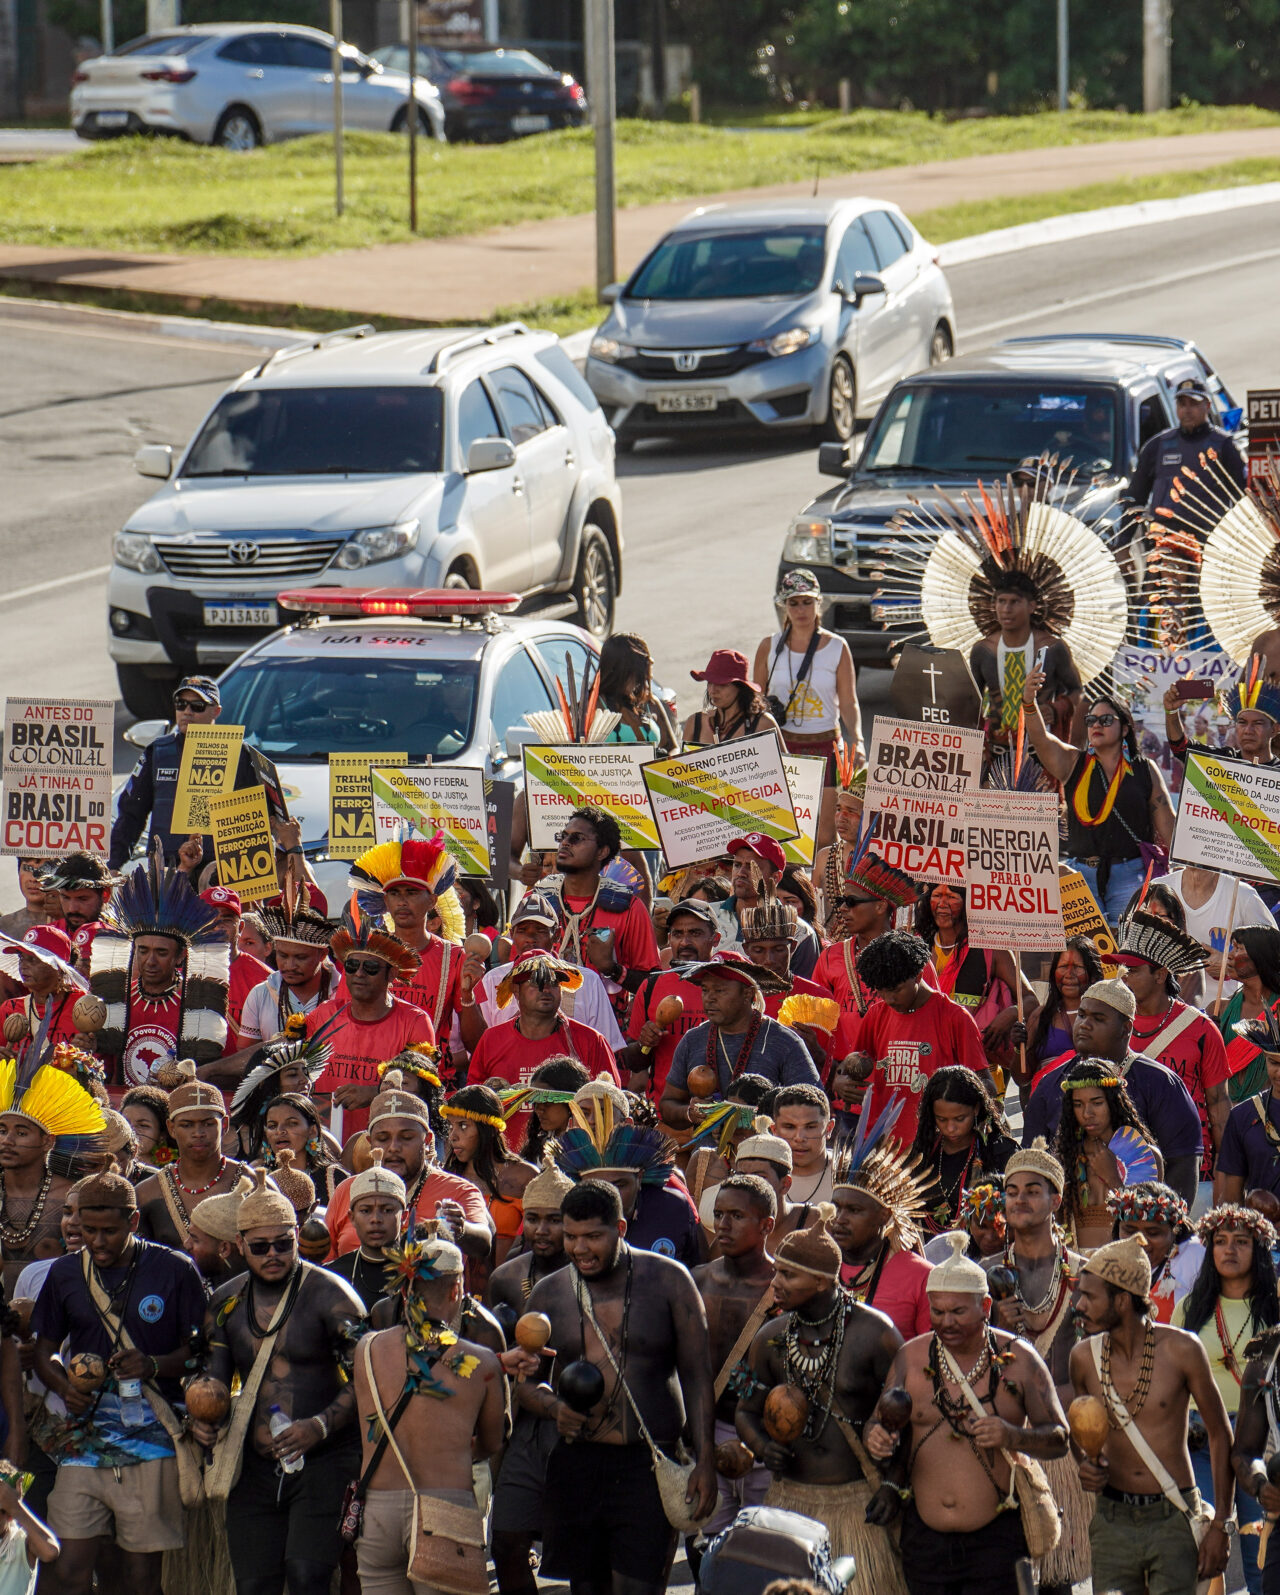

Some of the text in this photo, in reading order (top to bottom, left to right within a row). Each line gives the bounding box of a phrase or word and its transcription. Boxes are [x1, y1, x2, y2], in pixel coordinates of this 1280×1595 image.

[1125, 654, 1191, 674] POVO
[24, 706, 93, 720] ANTES DO
[922, 706, 950, 724] PEC
[12, 723, 104, 748] BRASIL
[892, 727, 962, 748] ANTES DO
[9, 747, 106, 766] COLONIAL
[193, 757, 227, 767] FERROGRÃO
[194, 748, 228, 756] DESTRUIÇÃO
[544, 755, 634, 764] GOVERNO FEDERAL
[668, 747, 759, 777] GOVERNO FEDERAL
[877, 742, 972, 777] BRASIL
[18, 773, 93, 790] JÁ TINHA O
[189, 765, 224, 786] NÃO
[390, 777, 468, 787] GOVERNO FEDERAL
[547, 768, 586, 776] MINISTÉRIO
[601, 769, 632, 777] JUSTIÇA
[673, 761, 760, 789] MINISTÉRIO DA JUSTIÇA
[1205, 766, 1254, 785] GOVERNO
[532, 794, 648, 805] TERRA PROTEGIDA
[1205, 780, 1249, 797] MINISTÉRIO
[1250, 791, 1262, 800] DA
[8, 792, 104, 822] BRASIL DO
[662, 782, 782, 823] TERRA PROTEGIDA
[880, 794, 958, 817] JÁ TINHA O
[1186, 788, 1216, 802] Fundação
[1218, 795, 1245, 807] Nacional
[1246, 802, 1258, 810] dos
[1260, 804, 1280, 814] Povos
[216, 810, 264, 828] TRILHOS DA
[420, 816, 482, 830] PROTEGIDA
[1184, 803, 1230, 824] TERRA
[5, 820, 105, 851] COCAR
[217, 820, 266, 838] DESTRUIÇÃO
[869, 810, 964, 848] BRASIL DO
[967, 826, 1052, 852] ENERGIA
[218, 834, 269, 855] FERROGRÃO
[220, 849, 272, 885] NÃO
[968, 850, 1055, 874] POSITIVA
[990, 871, 1032, 886] PARA O
[970, 884, 1058, 914] BRASIL
[134, 1028, 156, 1036] Povos
